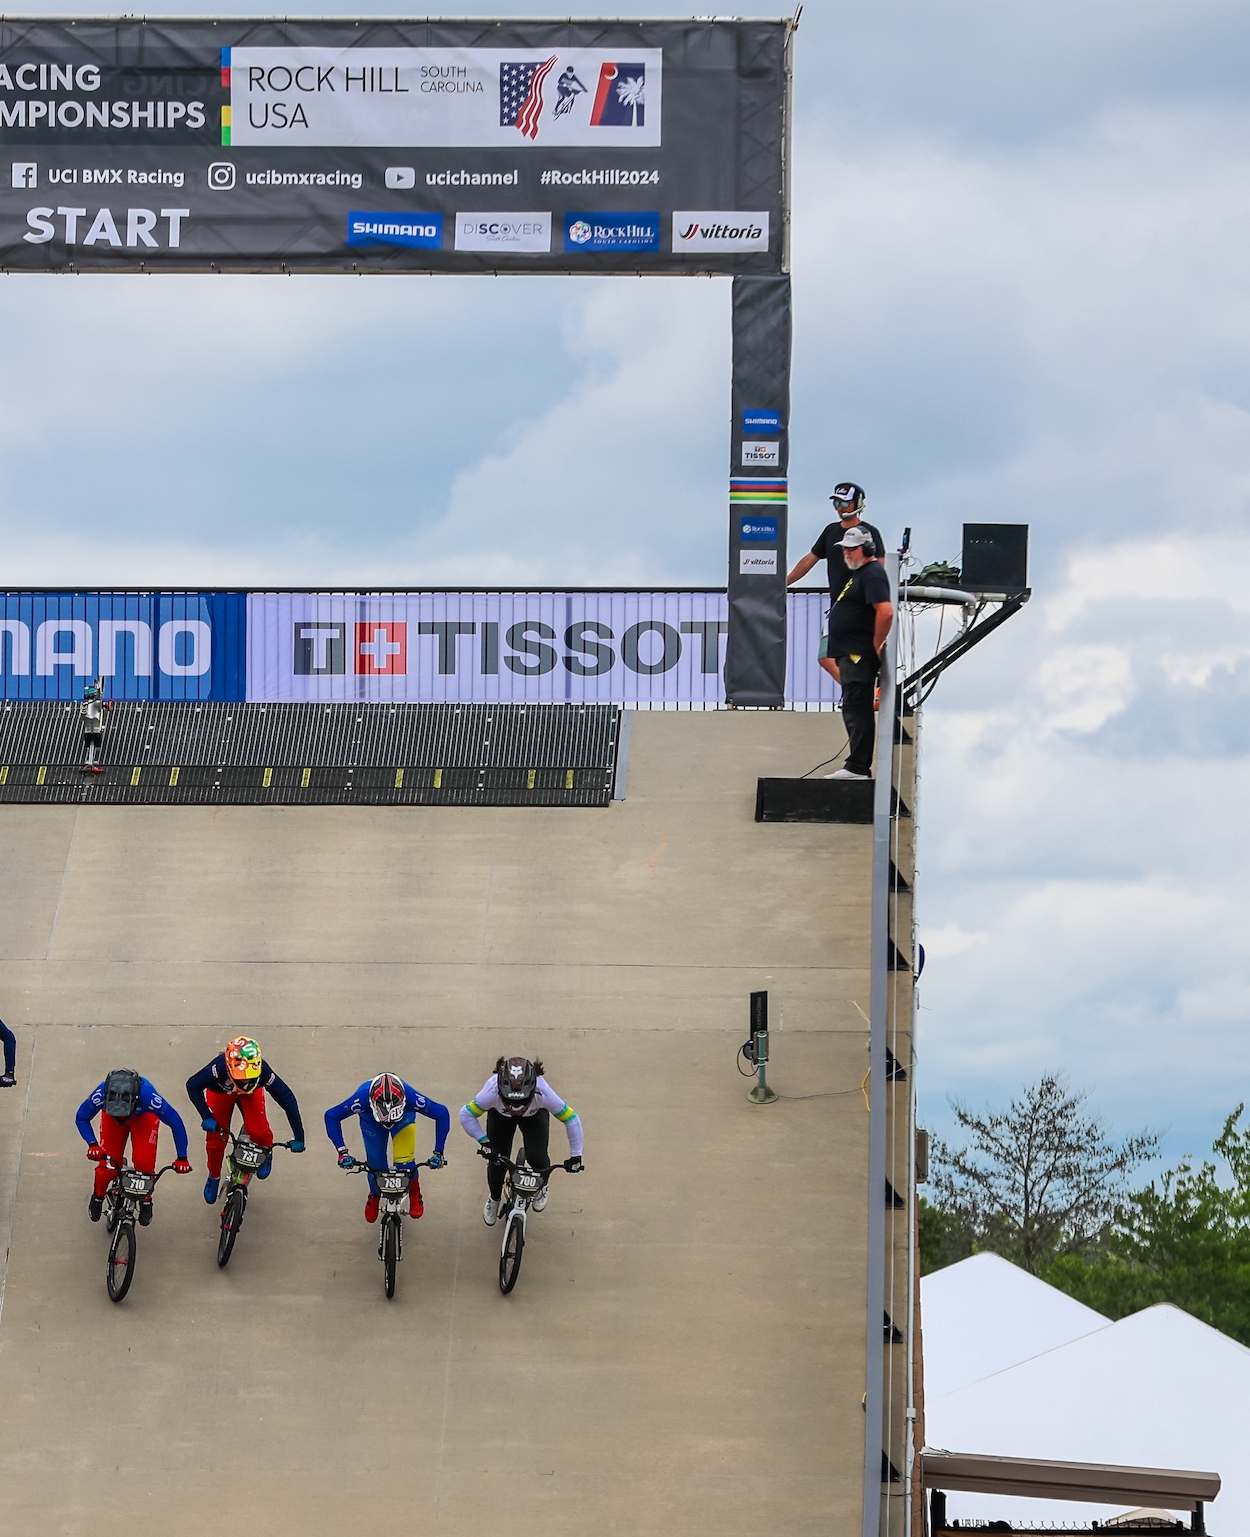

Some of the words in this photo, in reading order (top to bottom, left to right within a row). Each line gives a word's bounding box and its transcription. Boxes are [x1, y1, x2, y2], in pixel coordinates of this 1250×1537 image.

[248, 65, 335, 93] ROCK
[345, 66, 410, 93] HILL
[419, 65, 467, 79] SOUTH
[419, 81, 484, 94] CAROLINA
[248, 102, 310, 129] USA
[48, 168, 79, 184] UCI
[82, 169, 123, 185] BMX
[126, 168, 186, 188] Racing
[246, 170, 363, 190] ucibmxracing
[425, 169, 519, 186] ucichannel
[540, 169, 661, 186] #RockHill2024
[21, 206, 190, 248] START
[353, 222, 437, 237] SHIMANO
[463, 223, 543, 235] DISCOVER
[700, 223, 763, 239] vittoria
[417, 620, 729, 677] TISSOT
[129, 1178, 146, 1190] 710
[519, 1174, 537, 1187] 700
